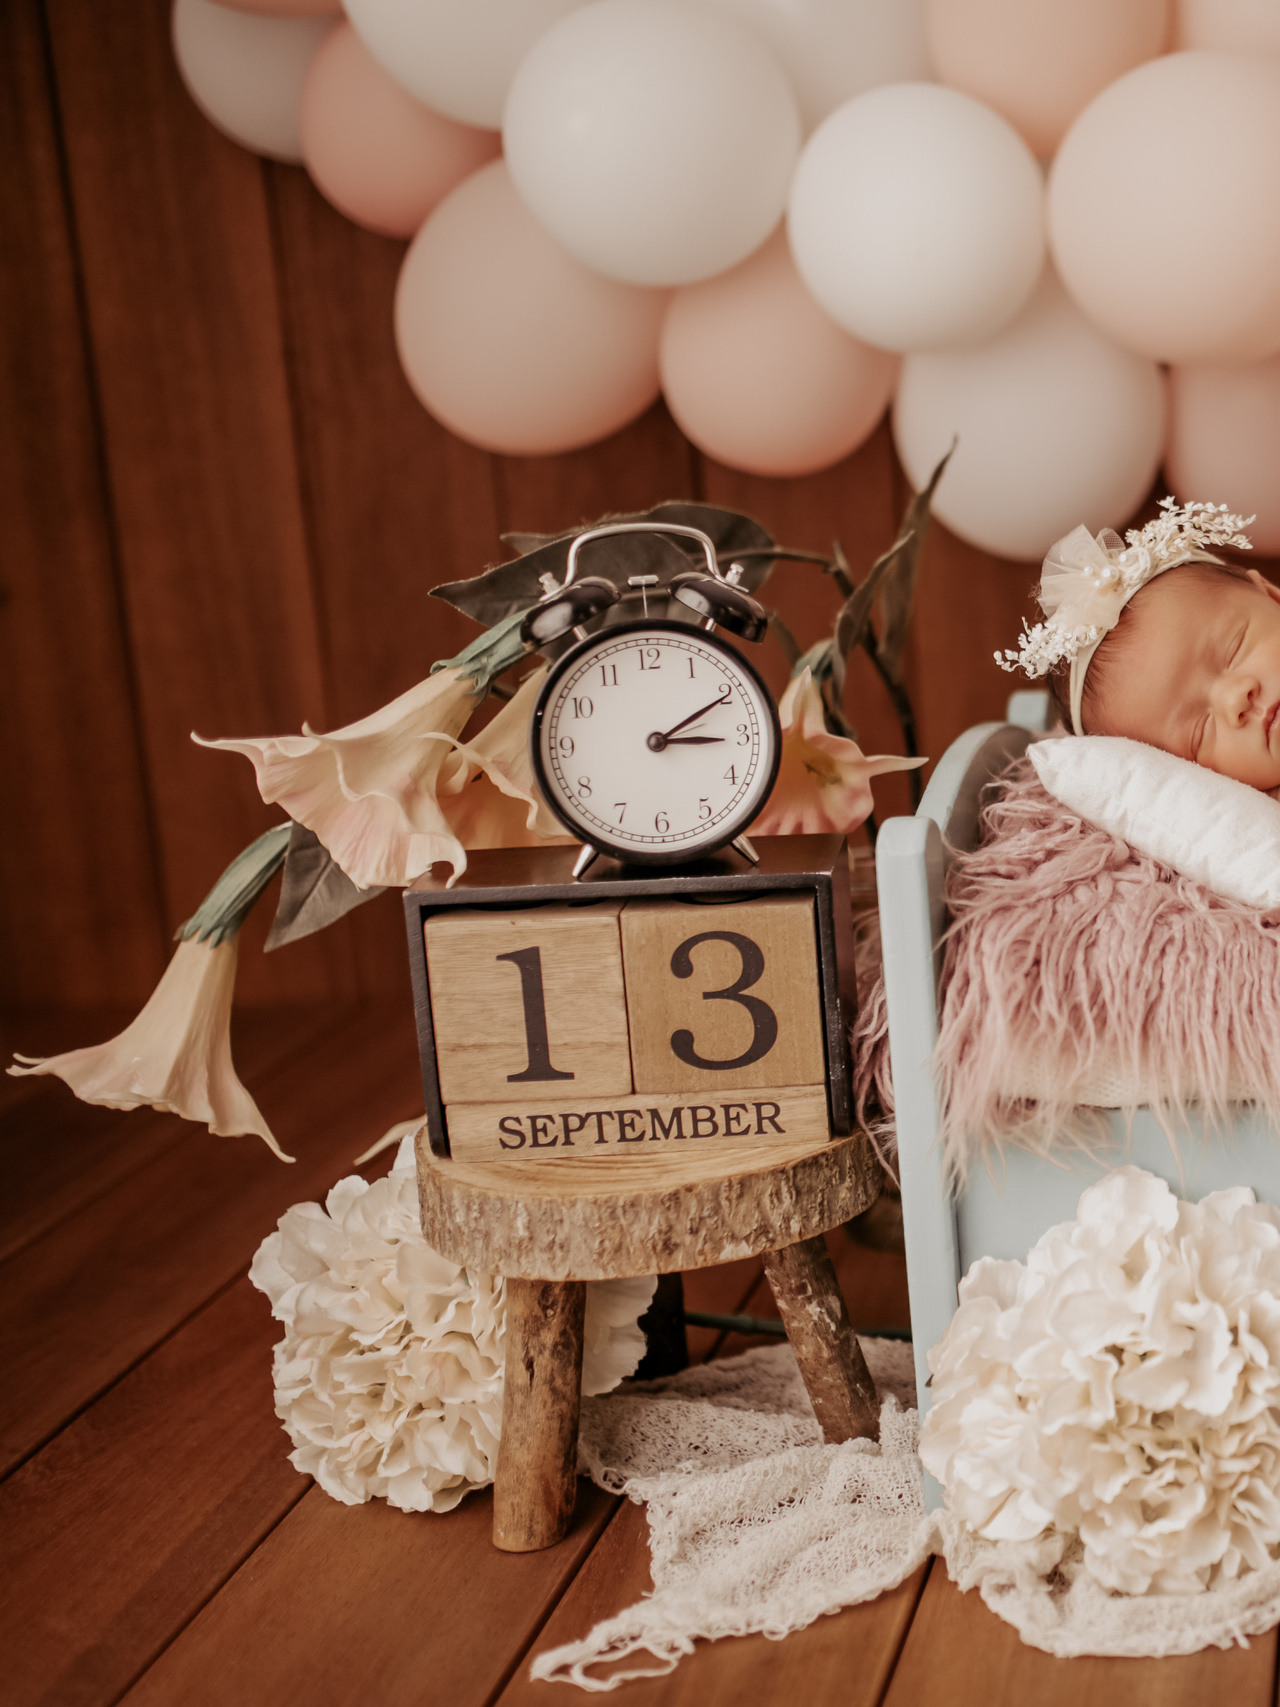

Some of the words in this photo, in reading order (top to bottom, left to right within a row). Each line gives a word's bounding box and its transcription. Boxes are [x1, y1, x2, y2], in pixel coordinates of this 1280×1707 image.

[637, 648, 661, 671] 12
[687, 657, 696, 679] 1
[599, 664, 619, 687] 11
[718, 683, 733, 704] 2
[572, 696, 594, 719] 10
[736, 723, 749, 746] 3
[559, 736, 575, 758] 9
[723, 764, 739, 785] 4
[577, 776, 592, 798] 8
[613, 802, 627, 824] 7
[698, 798, 712, 820] 5
[654, 811, 670, 833] 6
[498, 1101, 786, 1150] SEPTEMBER
